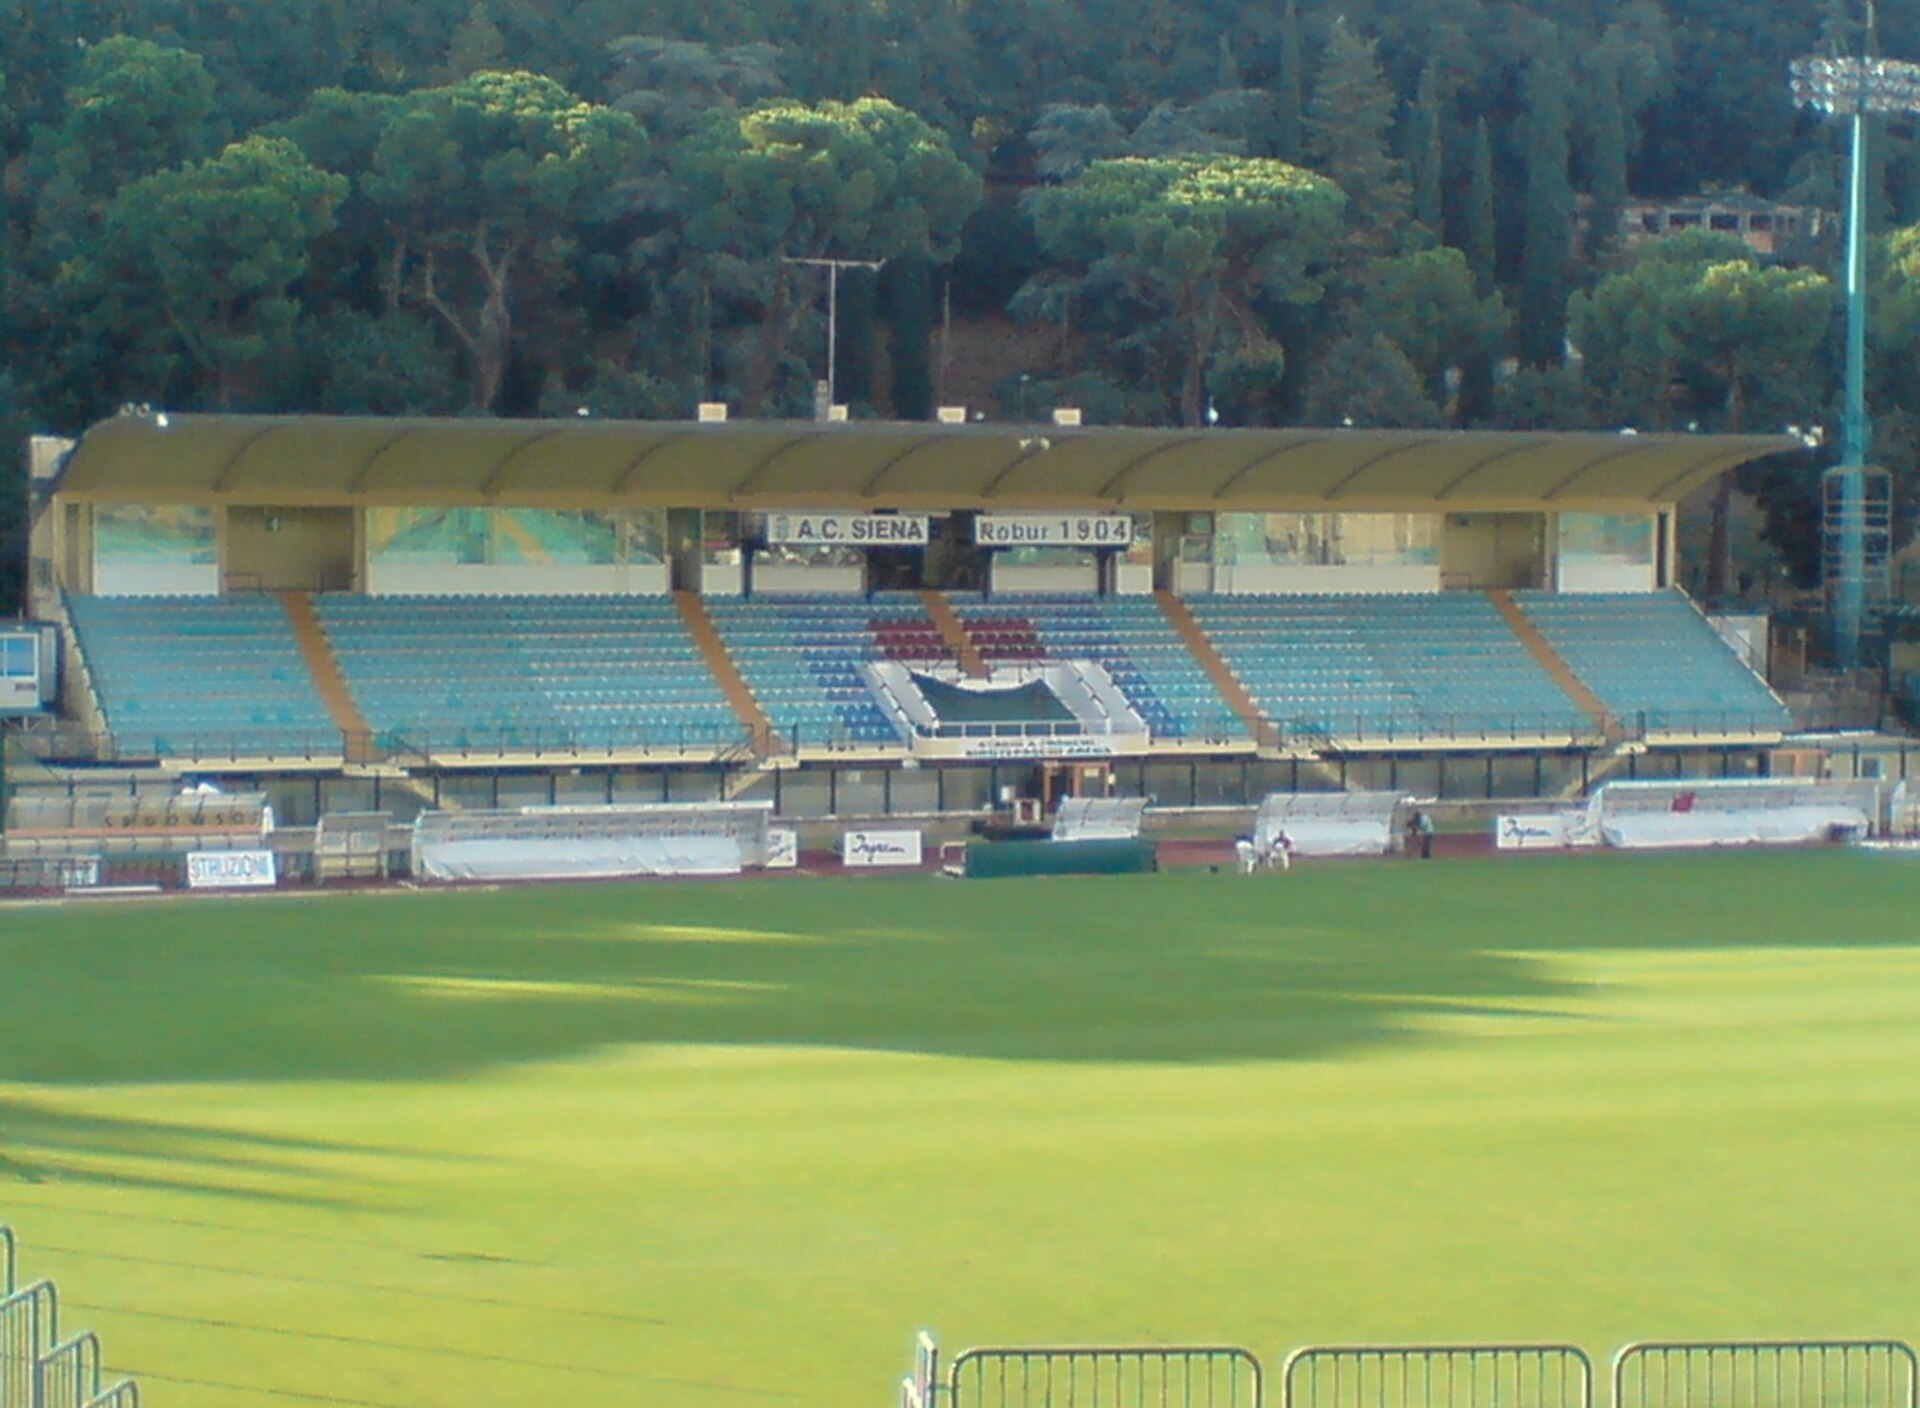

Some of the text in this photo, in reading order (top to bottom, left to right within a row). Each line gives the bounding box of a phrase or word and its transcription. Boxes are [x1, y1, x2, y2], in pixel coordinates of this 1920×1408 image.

[851, 518, 923, 540] SIENA
[979, 519, 1127, 541] Robur 1904
